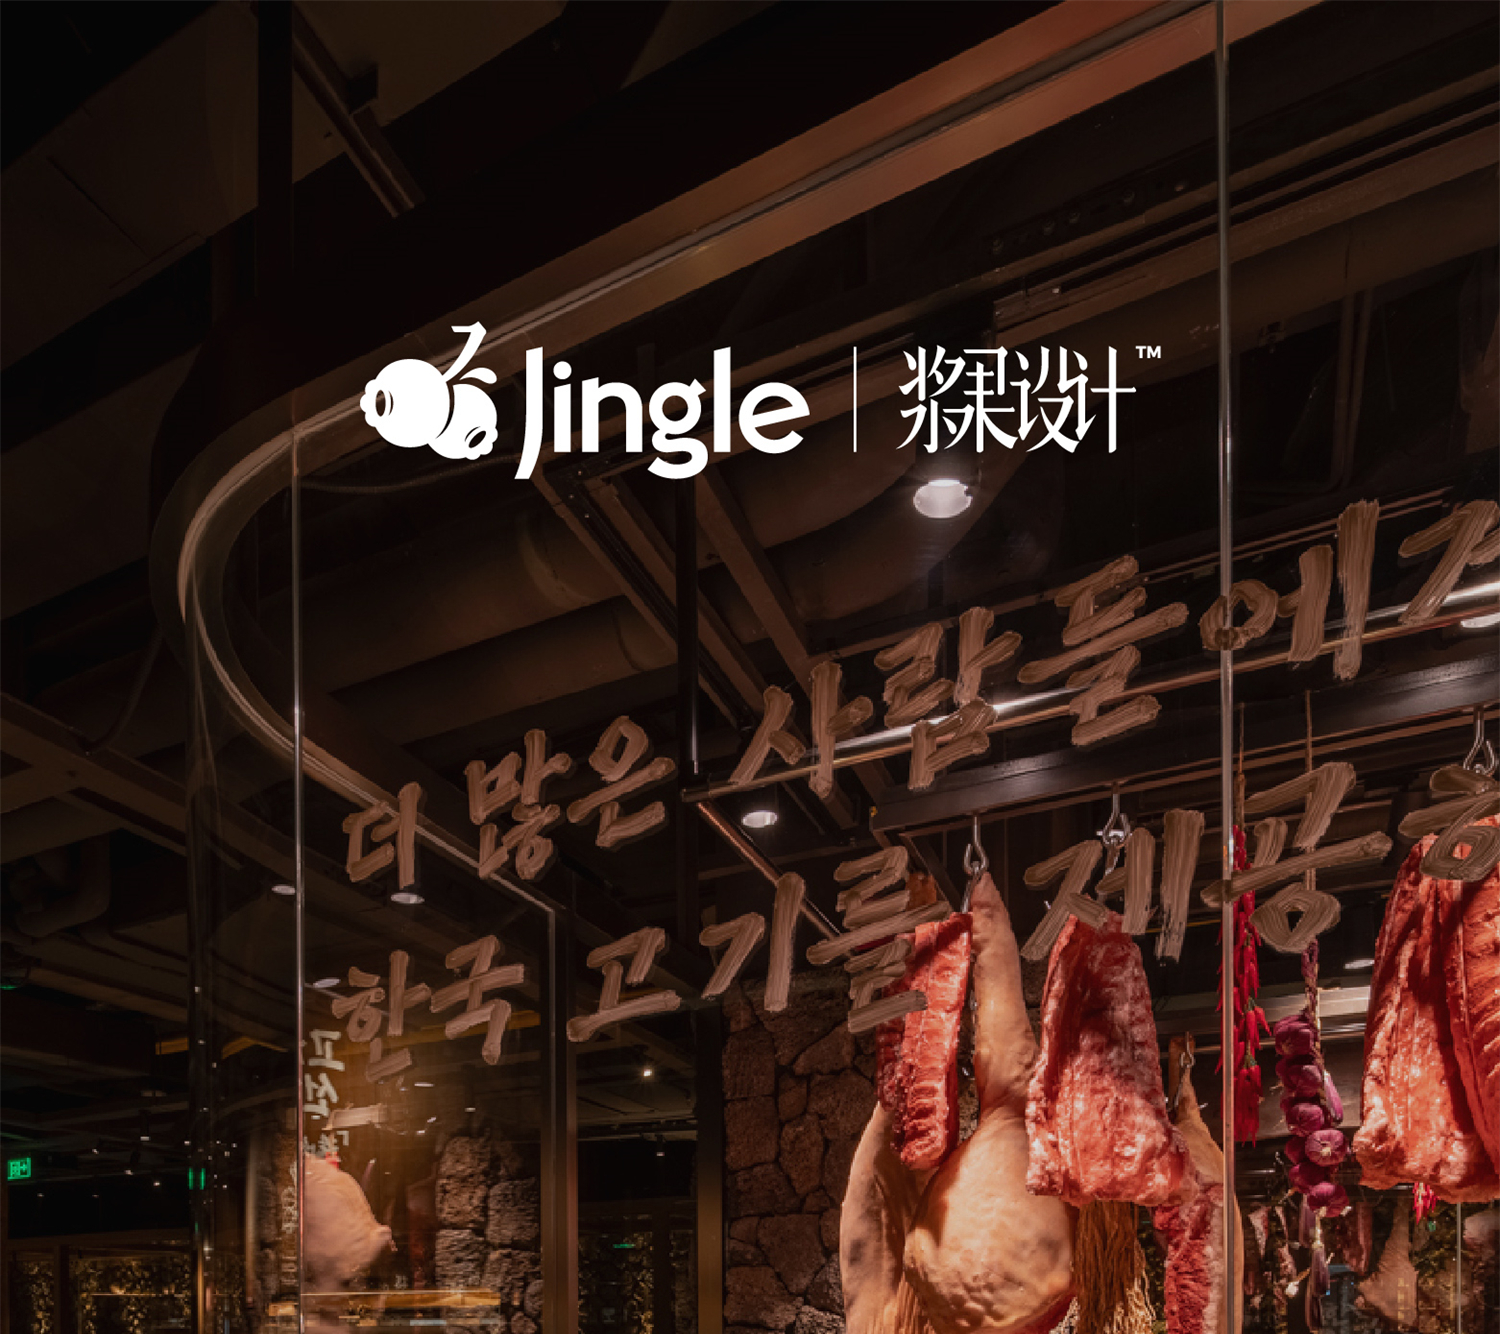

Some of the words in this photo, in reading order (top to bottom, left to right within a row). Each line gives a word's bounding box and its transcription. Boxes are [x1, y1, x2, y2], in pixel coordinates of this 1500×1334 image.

[342, 781, 423, 889] 더
[464, 715, 677, 881] 많은
[331, 934, 525, 1084] 한국
